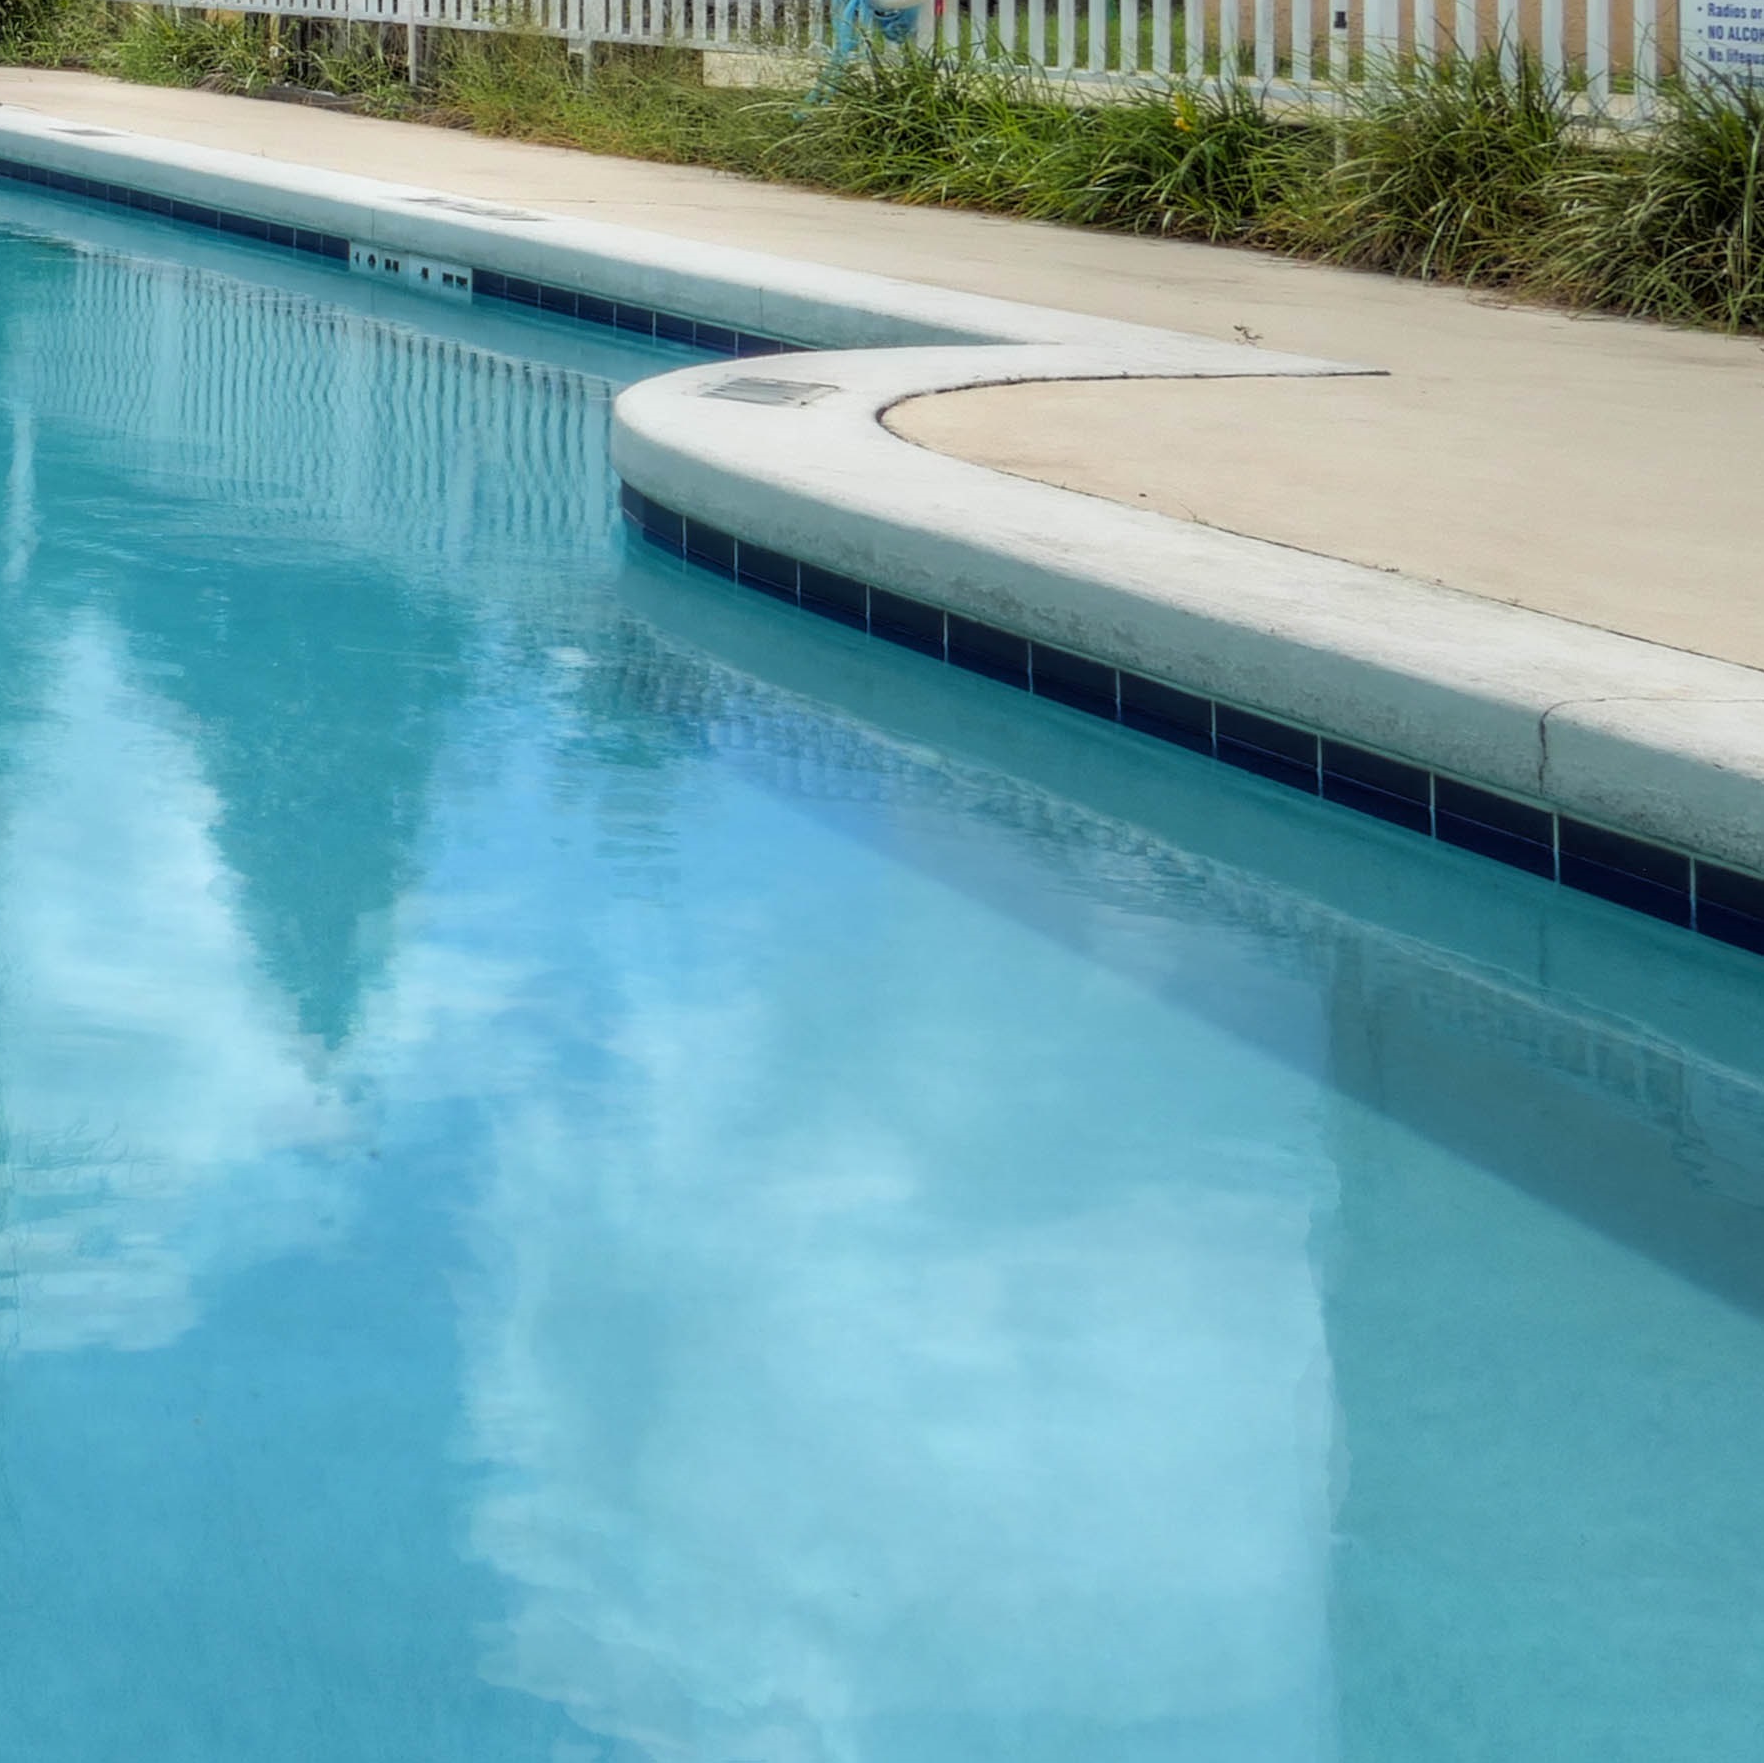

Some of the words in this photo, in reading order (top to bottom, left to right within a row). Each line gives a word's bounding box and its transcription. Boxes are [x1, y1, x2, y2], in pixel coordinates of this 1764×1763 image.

[1707, 2, 1747, 19] Radios
[1751, 8, 1763, 19] or
[1708, 25, 1724, 40] NO
[1708, 47, 1723, 62] No
